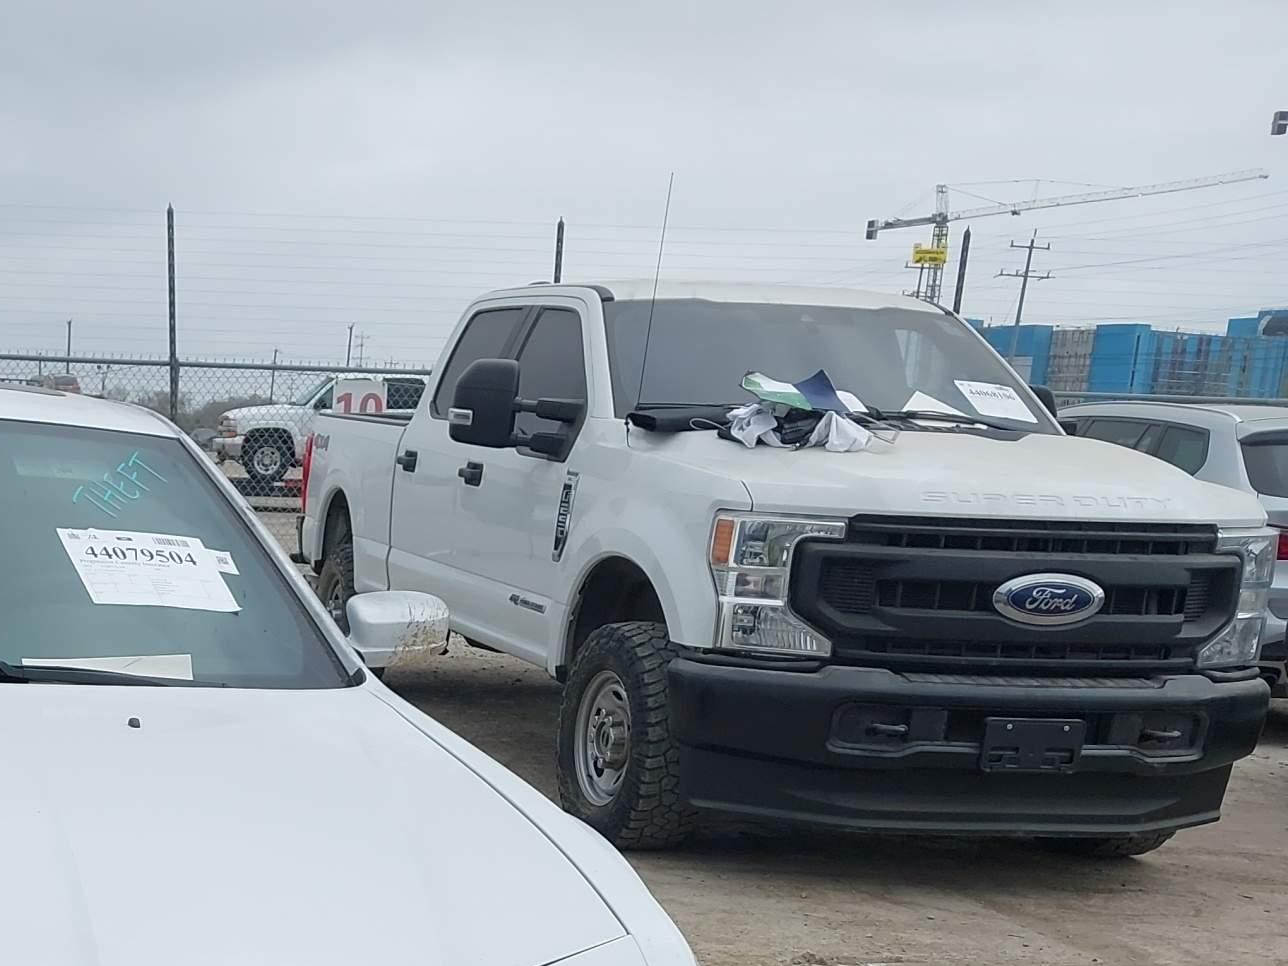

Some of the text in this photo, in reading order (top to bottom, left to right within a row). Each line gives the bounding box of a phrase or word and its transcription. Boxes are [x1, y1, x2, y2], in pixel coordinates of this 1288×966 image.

[72, 451, 169, 519] THEFT
[921, 490, 1173, 510] SUPER DUTY
[85, 545, 198, 567] 44079504
[1024, 586, 1079, 612] Ford
